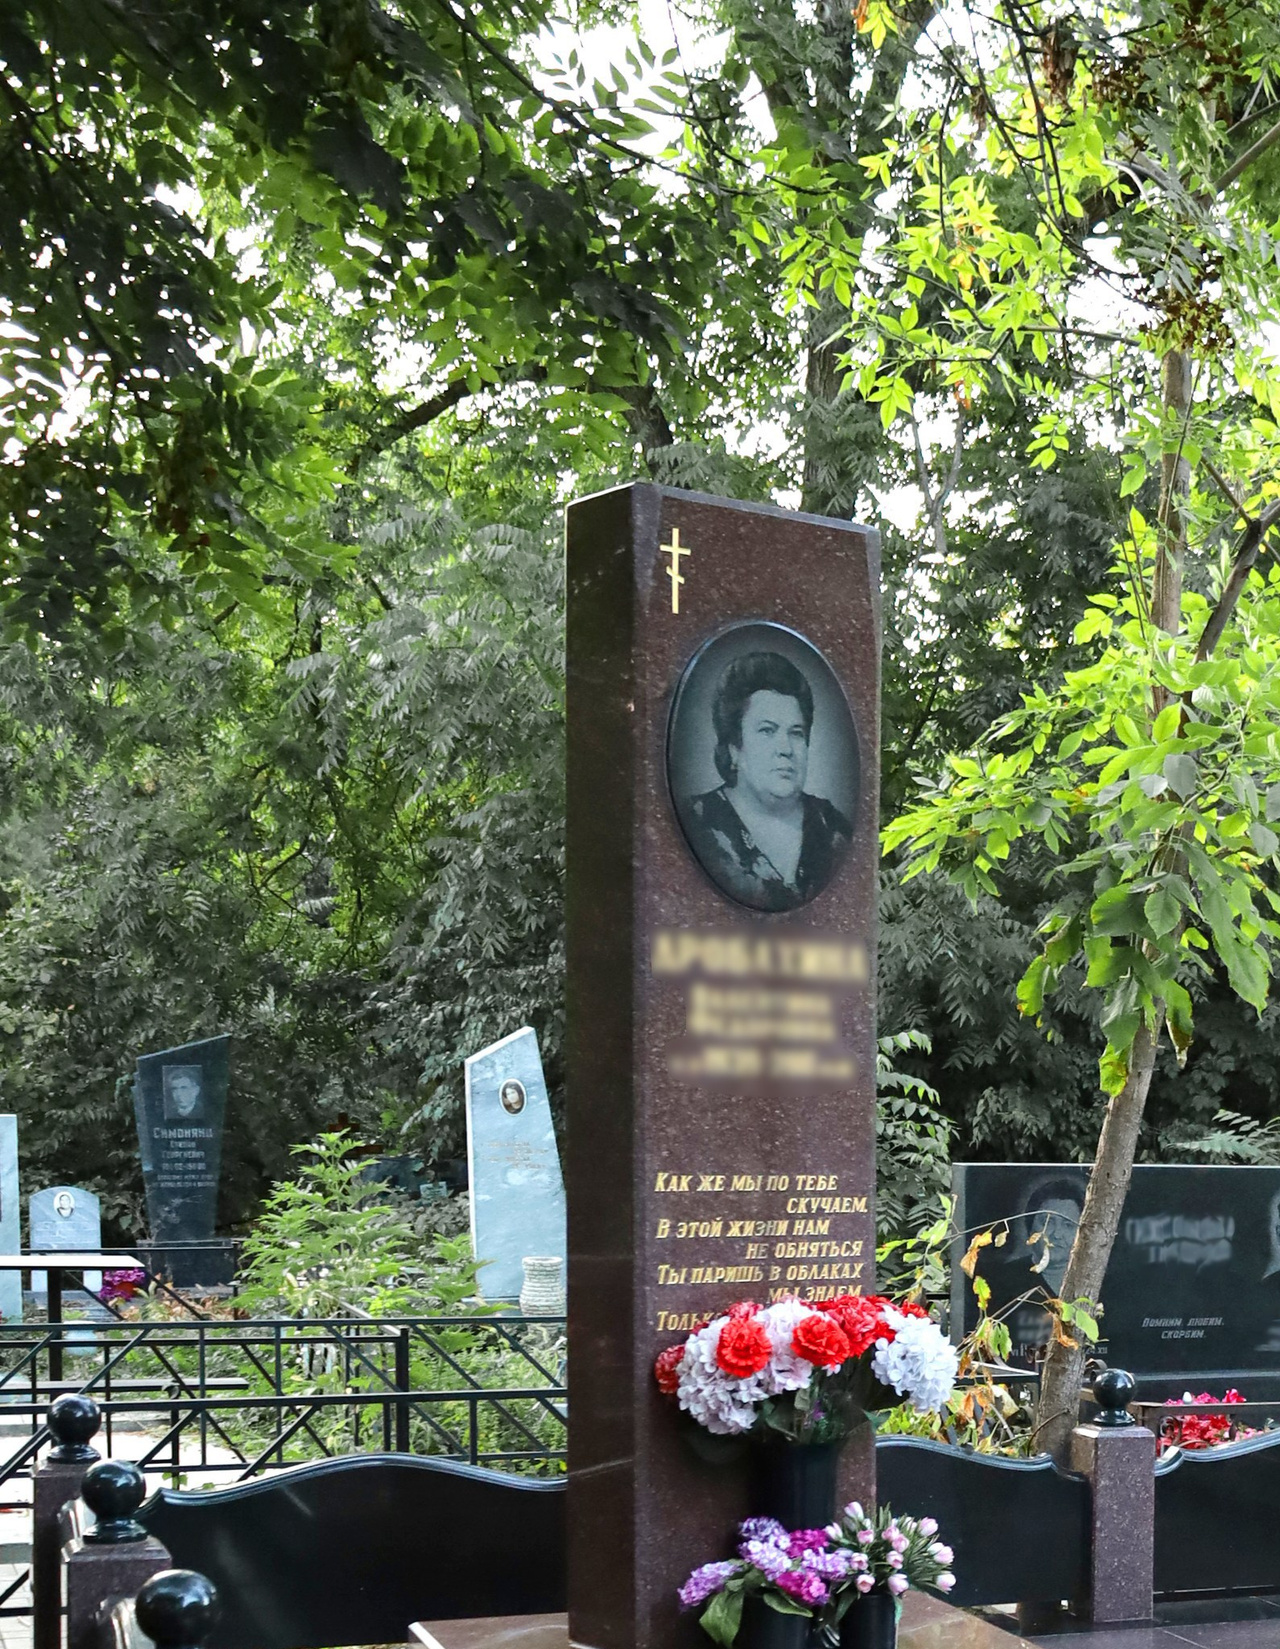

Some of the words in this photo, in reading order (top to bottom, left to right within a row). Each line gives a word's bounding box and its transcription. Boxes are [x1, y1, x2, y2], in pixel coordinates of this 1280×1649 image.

[697, 1174, 727, 1192] ЖЕ
[730, 1174, 763, 1192] МЫ
[765, 1174, 790, 1192] ПО
[795, 1174, 839, 1192] ТЕБЕ
[786, 1196, 868, 1214] СКУЧАЕМ.
[655, 1218, 671, 1239] В
[675, 1216, 723, 1239] ЭТОЙ
[726, 1219, 789, 1237] ЖИЗНИ
[792, 1219, 831, 1236] НАМ
[745, 1242, 770, 1260] НЕ
[774, 1240, 863, 1259] ОБНЯТЬСЯ
[690, 1265, 764, 1284] ПАРИШЬ
[768, 1264, 781, 1281] В
[785, 1262, 865, 1281] ОБЛАКАХ
[657, 1311, 722, 1331] ТОЛЬК
